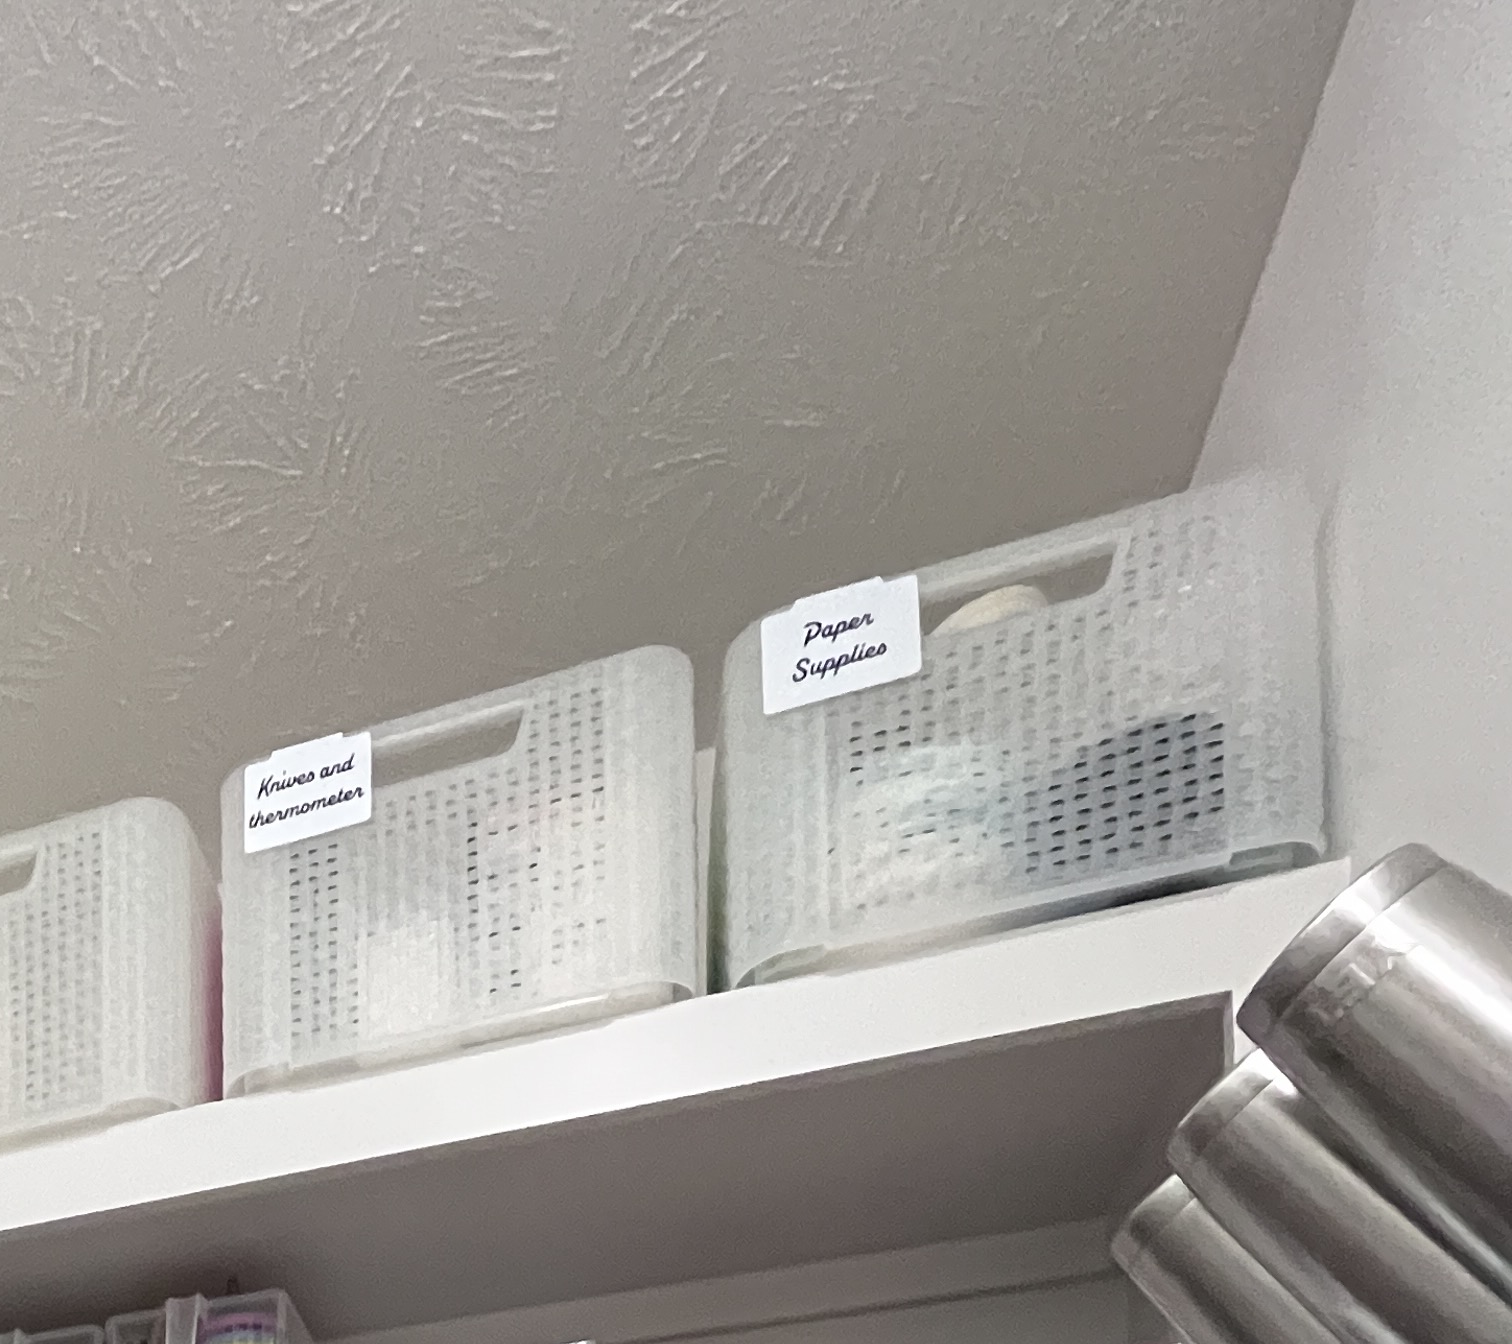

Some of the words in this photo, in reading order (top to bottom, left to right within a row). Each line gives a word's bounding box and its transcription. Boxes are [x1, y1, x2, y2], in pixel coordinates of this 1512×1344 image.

[804, 612, 875, 647] Paper
[791, 642, 888, 683] Supplies
[256, 769, 315, 800] Knives
[320, 752, 355, 779] and
[248, 786, 365, 829] thermometer
